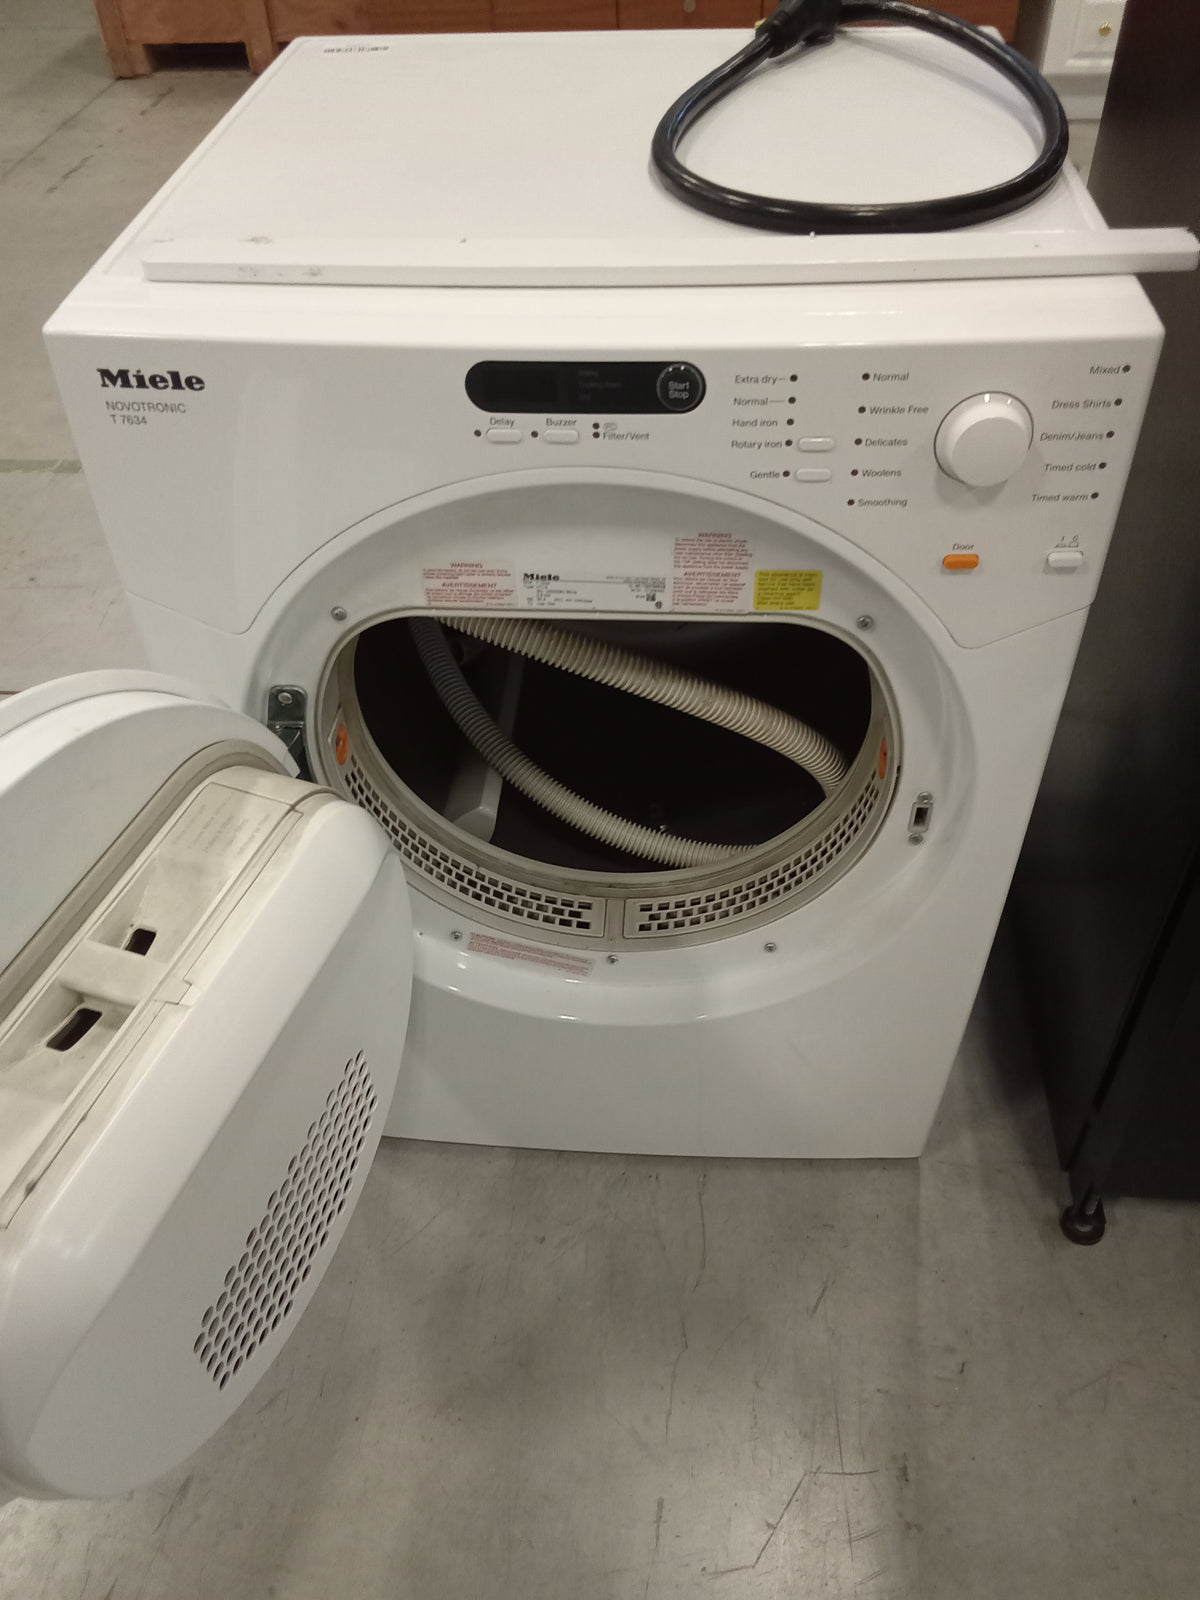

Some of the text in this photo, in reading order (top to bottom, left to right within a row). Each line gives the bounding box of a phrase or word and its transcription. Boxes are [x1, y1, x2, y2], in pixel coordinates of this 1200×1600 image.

[1089, 365, 1120, 375] Mixed
[96, 368, 206, 391] Miele
[735, 375, 777, 385] Extra dry
[873, 372, 909, 382] Normal
[668, 380, 690, 390] Start
[668, 390, 690, 400] Stop
[733, 397, 768, 406] Normal
[1052, 399, 1111, 409] Dress Shirts
[105, 401, 186, 414] NOVOTRONIC
[870, 405, 929, 415] Wrinkle Free
[110, 414, 147, 426] T 7634
[489, 417, 515, 427] Delay
[546, 418, 577, 427] Buzzer
[732, 418, 777, 427] Hand iron
[602, 431, 650, 441] Filter/Vent
[1040, 432, 1103, 441] Denim/Jeans
[731, 439, 782, 450] Rotary iron
[865, 438, 908, 447] Delicates
[1044, 462, 1096, 472] Timed cold
[750, 470, 780, 479] Gentle
[862, 469, 902, 478] Woolens
[1032, 493, 1088, 502] Timed warm
[858, 498, 907, 508] Smoothing
[952, 543, 974, 551] Door
[522, 572, 560, 582] Miele
